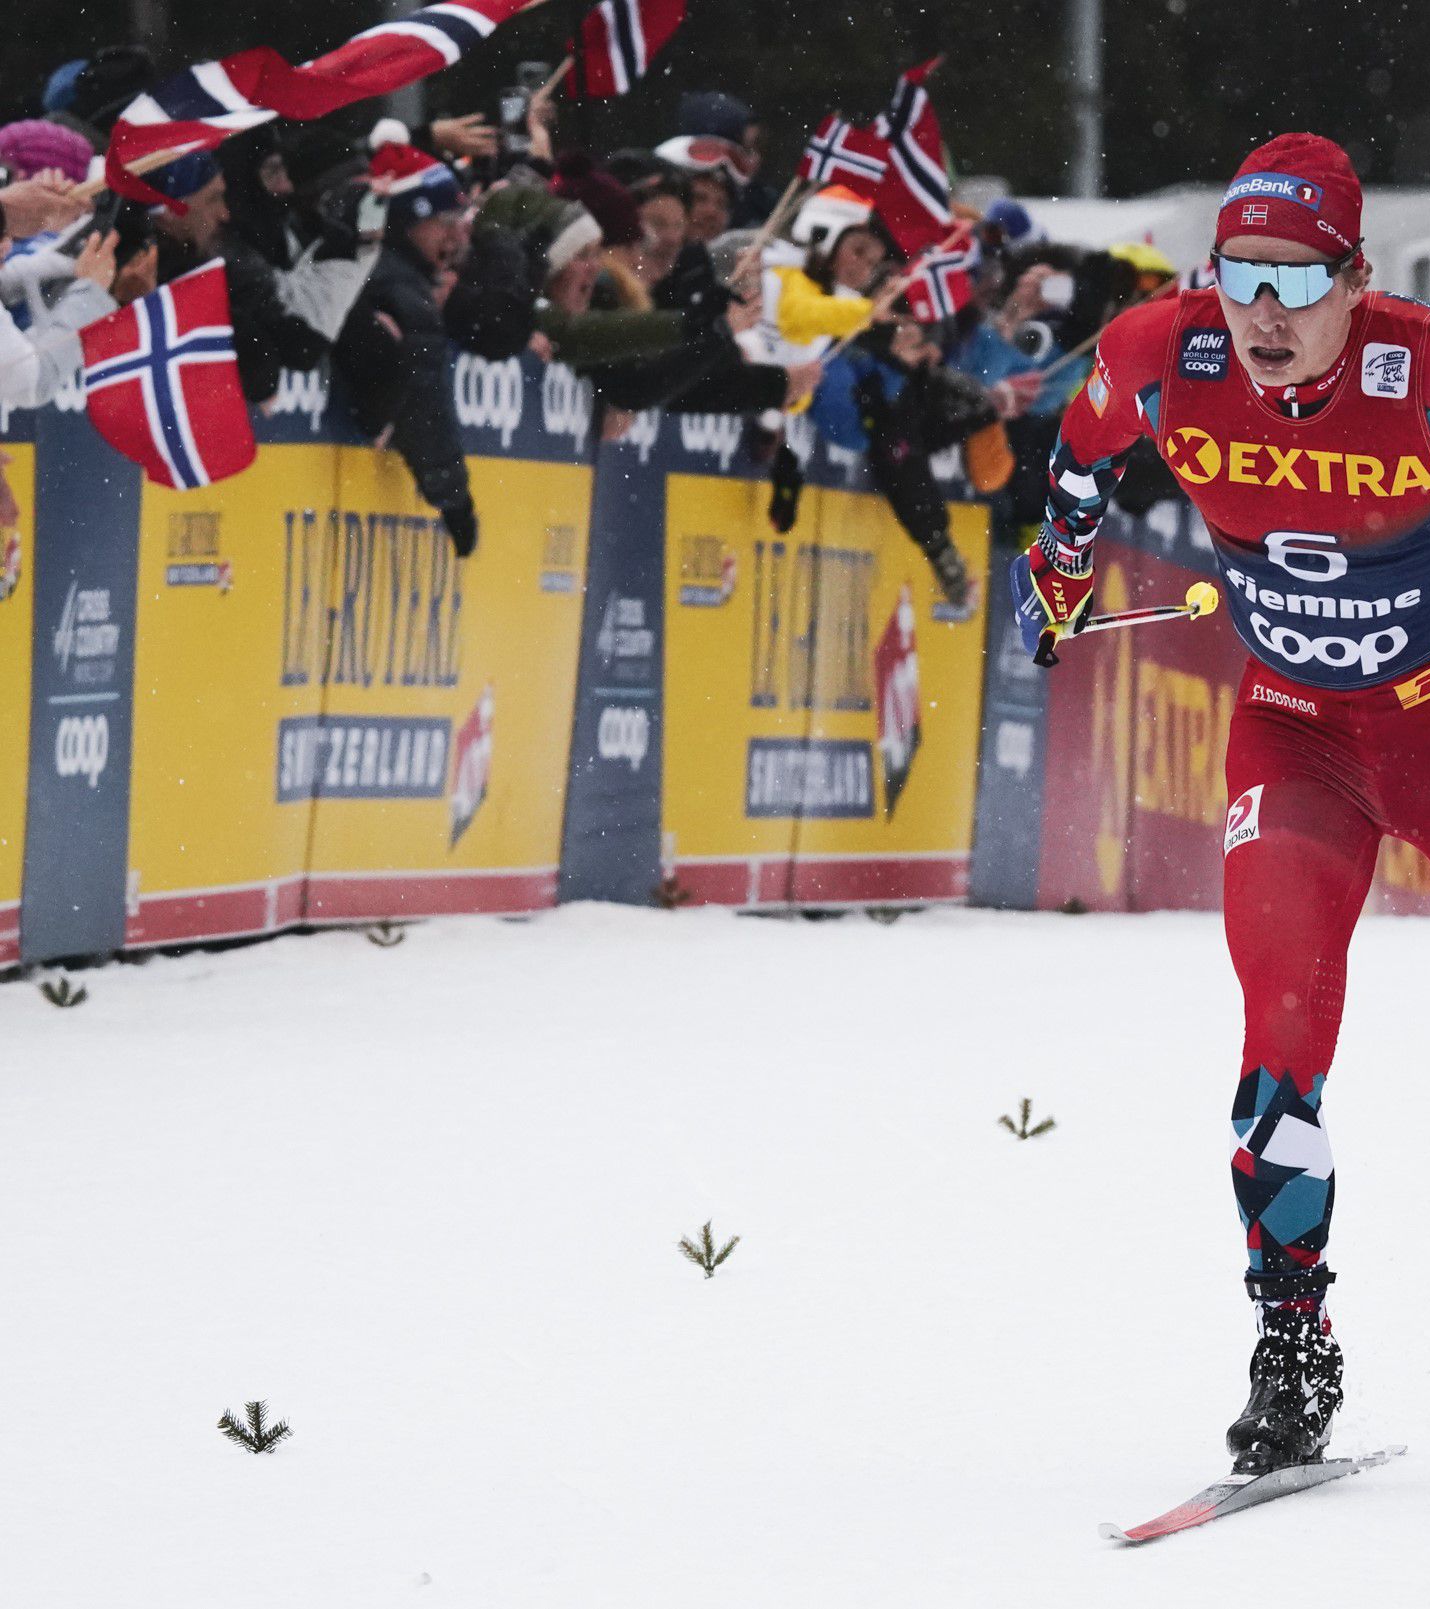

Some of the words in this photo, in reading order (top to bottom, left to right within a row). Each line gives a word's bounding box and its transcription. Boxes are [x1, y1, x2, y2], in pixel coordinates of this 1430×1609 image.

[1183, 351, 1209, 359] WORLD
[1185, 361, 1220, 374] coop
[454, 353, 523, 449] coop
[1264, 531, 1348, 582] 6
[1051, 581, 1068, 621] LEKI
[1250, 611, 1409, 676] coop
[1251, 683, 1318, 716] ELDORADO
[55, 714, 109, 788] coop
